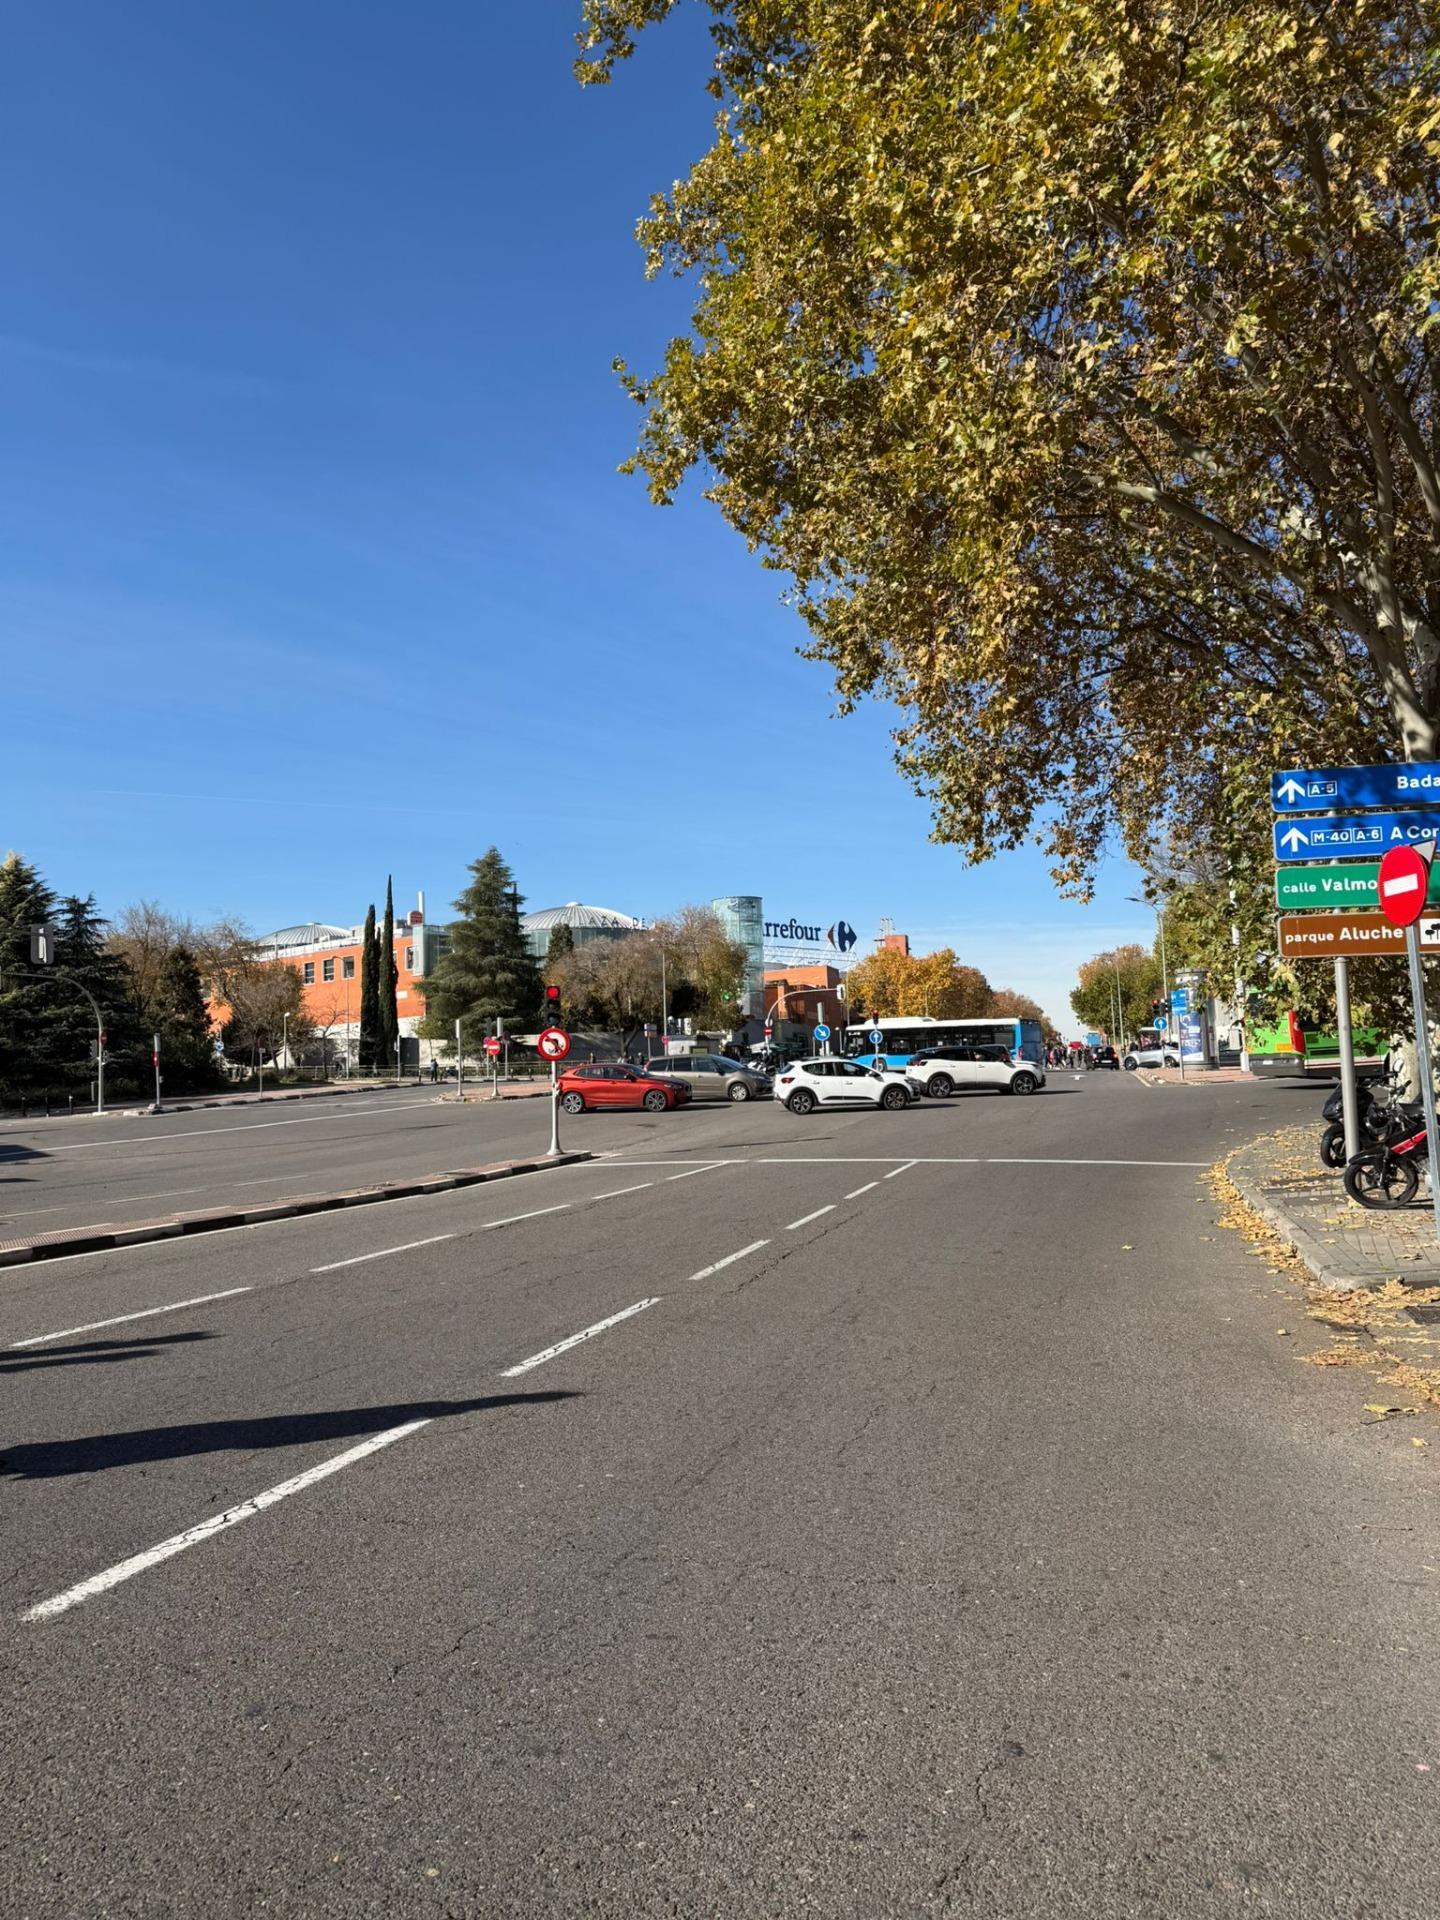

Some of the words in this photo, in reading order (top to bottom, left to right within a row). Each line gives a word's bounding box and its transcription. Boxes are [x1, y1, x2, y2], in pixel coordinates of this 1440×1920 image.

[1311, 783, 1334, 794] A-5
[1397, 774, 1440, 789] Bada
[1313, 831, 1349, 843] M-40
[1356, 829, 1379, 840] A-6
[1390, 826, 1403, 840] A
[1406, 825, 1439, 839] Cor
[1282, 881, 1316, 893] calle
[1321, 878, 1378, 892] Valmo
[763, 918, 821, 941] rrefour
[1285, 931, 1334, 944] parque
[1339, 926, 1404, 941] Aluche
